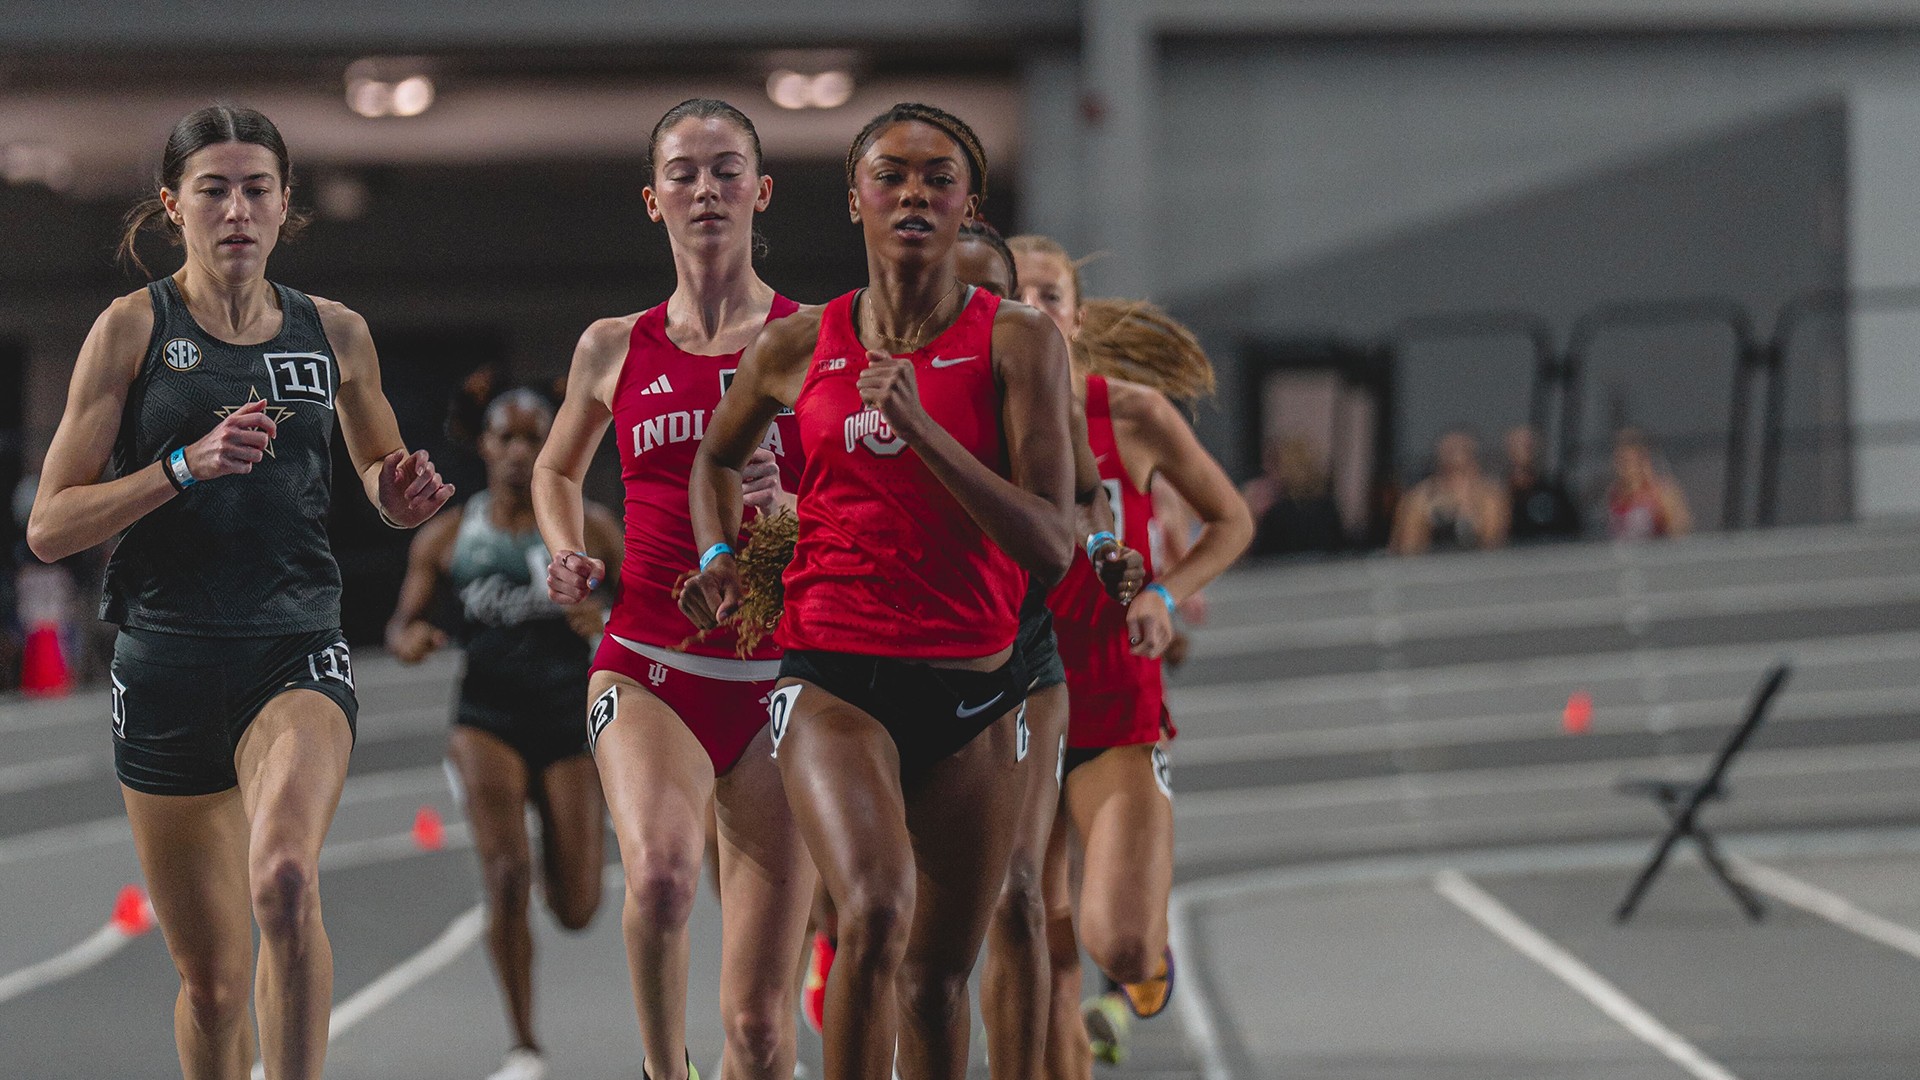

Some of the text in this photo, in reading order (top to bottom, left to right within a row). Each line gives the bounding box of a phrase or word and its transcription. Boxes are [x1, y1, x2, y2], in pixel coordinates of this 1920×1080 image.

[166, 341, 199, 368] SEC
[278, 361, 326, 396] 11
[632, 410, 785, 457] INDIA
